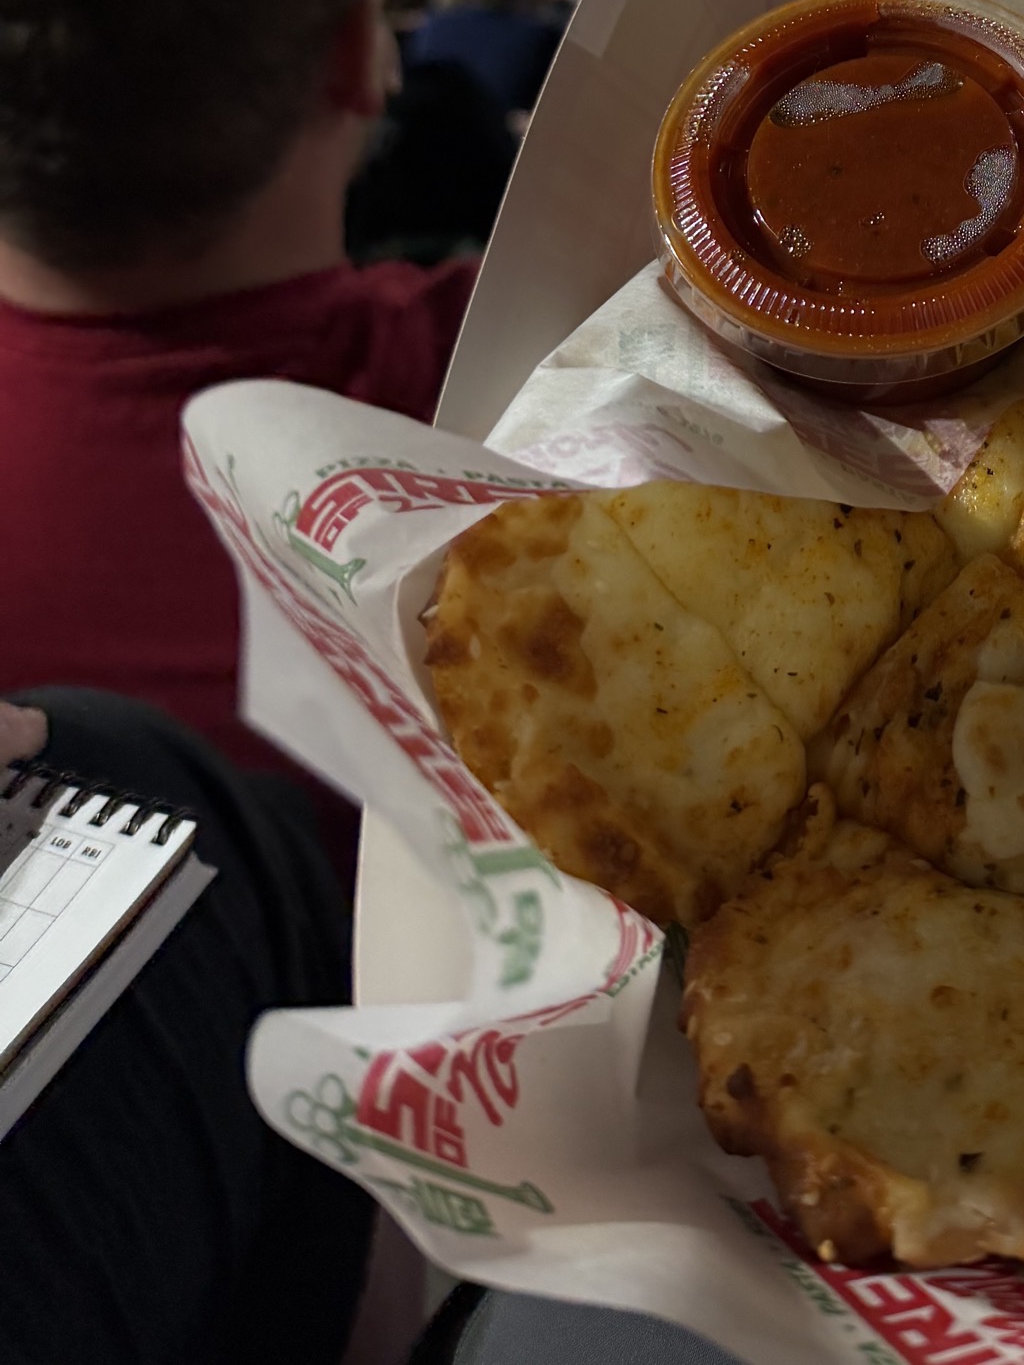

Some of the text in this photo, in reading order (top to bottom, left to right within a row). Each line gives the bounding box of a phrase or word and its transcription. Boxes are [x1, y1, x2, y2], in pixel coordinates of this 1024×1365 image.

[314, 493, 374, 552] OF
[51, 836, 72, 849] LOB
[82, 846, 102, 859] RBI
[434, 1094, 468, 1169] OF
